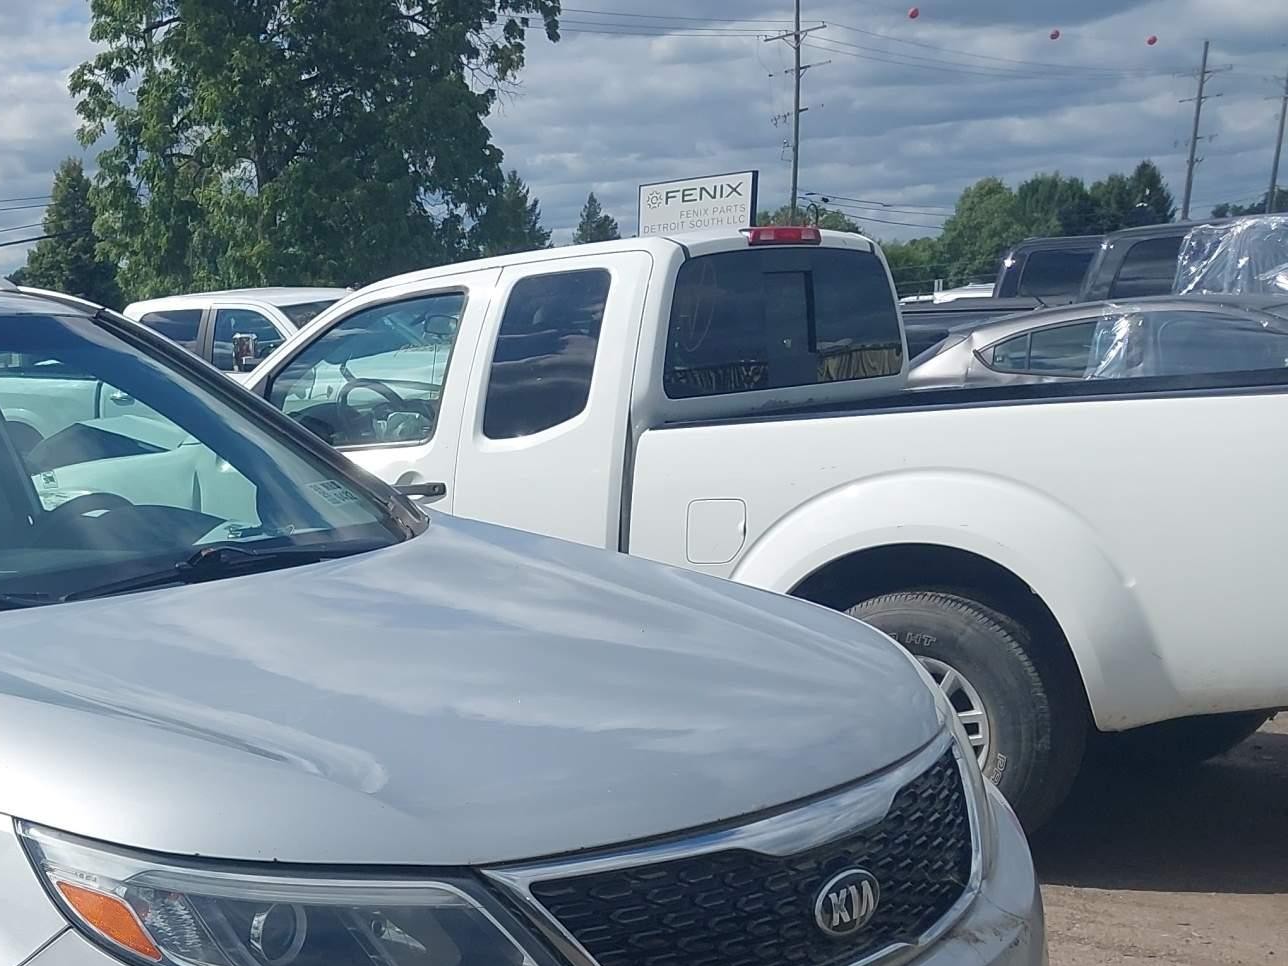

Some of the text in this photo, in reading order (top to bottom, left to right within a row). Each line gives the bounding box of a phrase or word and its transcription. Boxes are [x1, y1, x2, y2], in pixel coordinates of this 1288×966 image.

[665, 182, 743, 205] FENIX
[679, 203, 746, 220] FENIX PARTS
[643, 214, 746, 234] DETROIT SOUTH LLC
[828, 880, 874, 926] KIA
